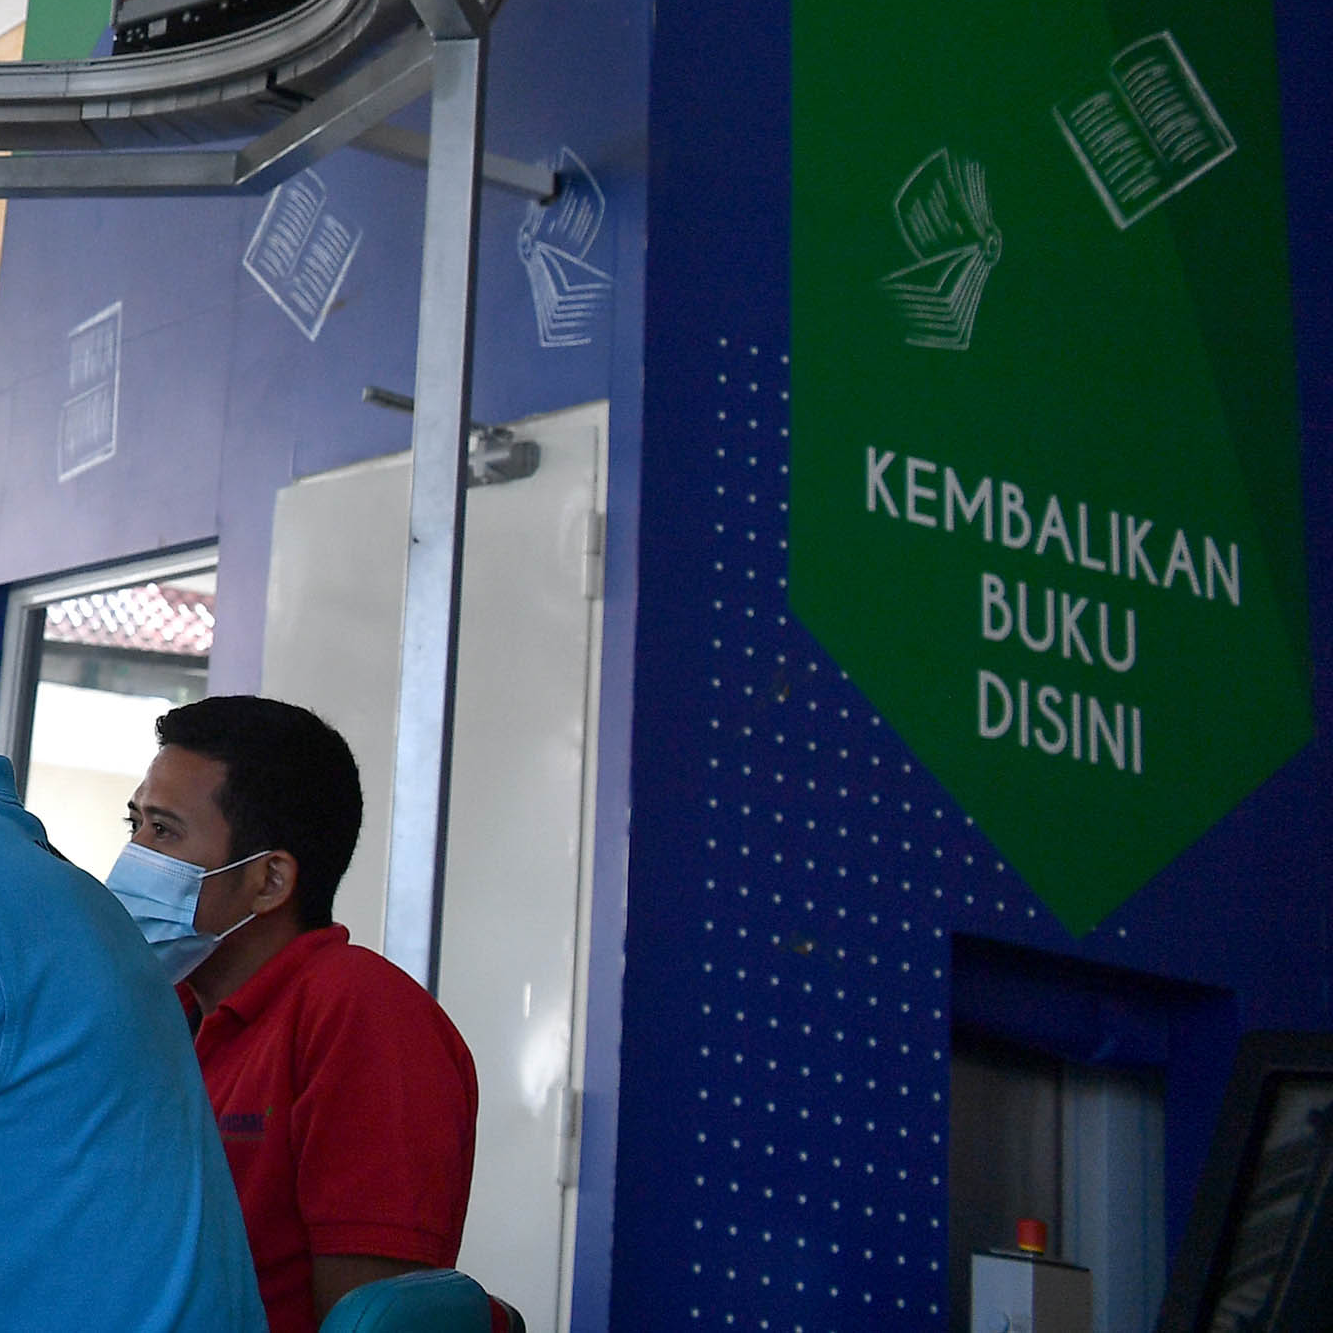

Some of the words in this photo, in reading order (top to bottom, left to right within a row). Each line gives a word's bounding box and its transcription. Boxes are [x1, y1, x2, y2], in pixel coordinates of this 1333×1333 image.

[865, 446, 1241, 607] KEMBALIKAN
[981, 572, 1135, 673] BUKU
[978, 669, 1143, 775] DISINI
